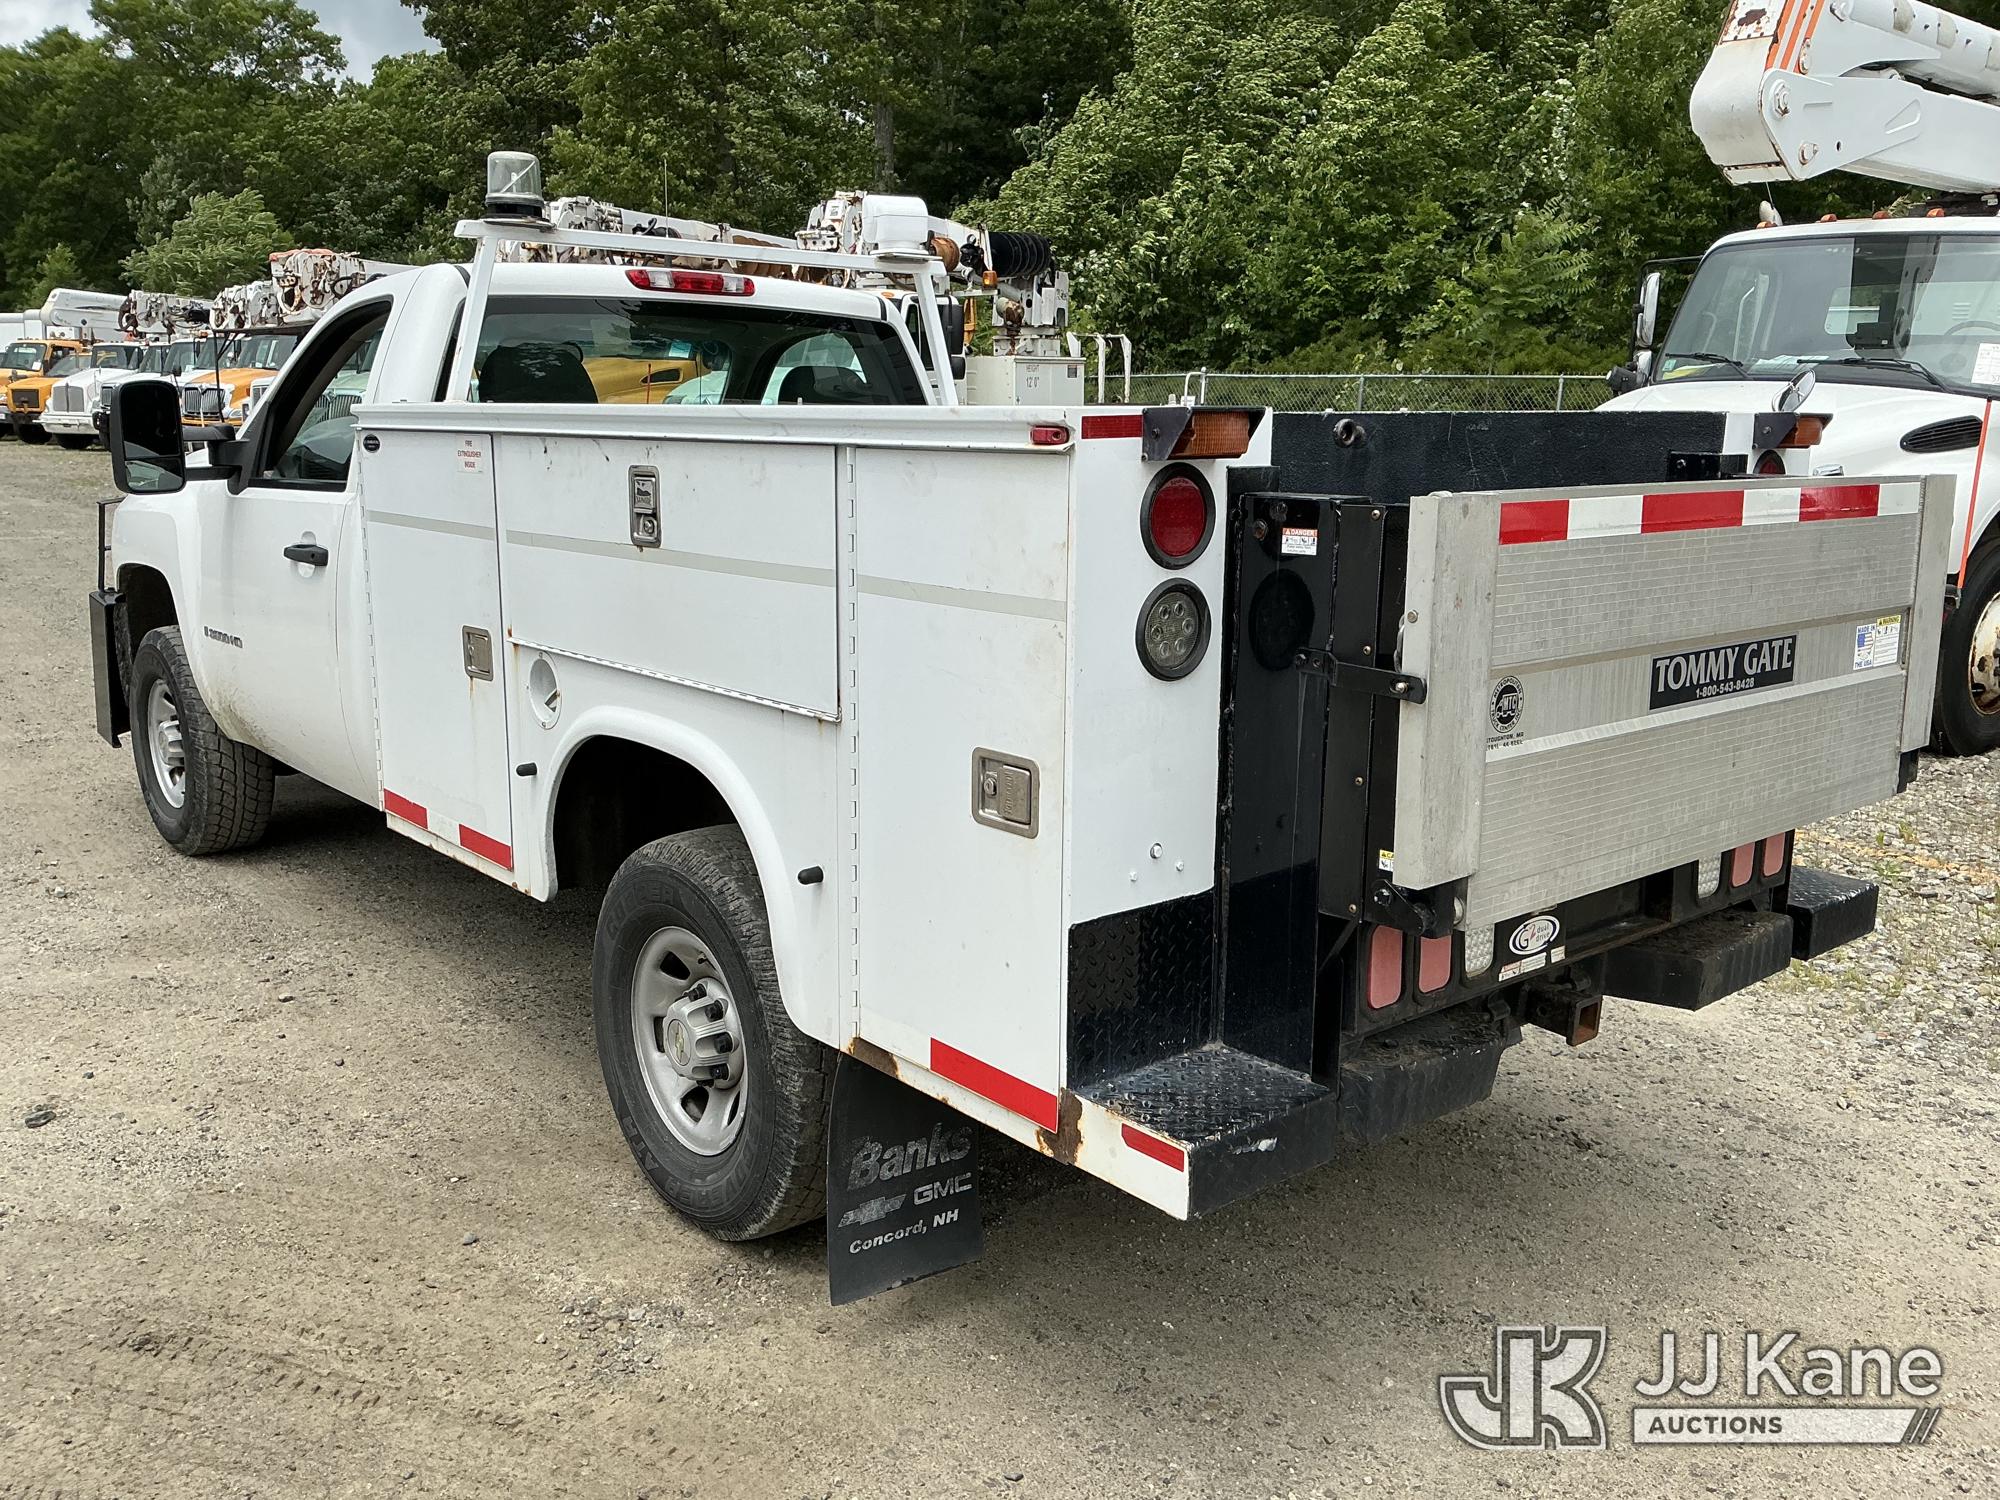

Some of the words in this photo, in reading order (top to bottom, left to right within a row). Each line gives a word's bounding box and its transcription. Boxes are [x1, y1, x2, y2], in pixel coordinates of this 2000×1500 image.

[1857, 625, 1870, 633] MADE
[1656, 646, 1740, 693] TOMMY
[1743, 638, 1793, 675] GATE
[1696, 677, 1755, 698] 1-800-543-8428
[1536, 932, 1549, 942] drive
[1537, 923, 1549, 933] dual
[848, 1122, 974, 1192] Banks
[913, 1172, 973, 1206] GMC
[849, 1219, 927, 1254] Concord,
[932, 1208, 959, 1228] NH
